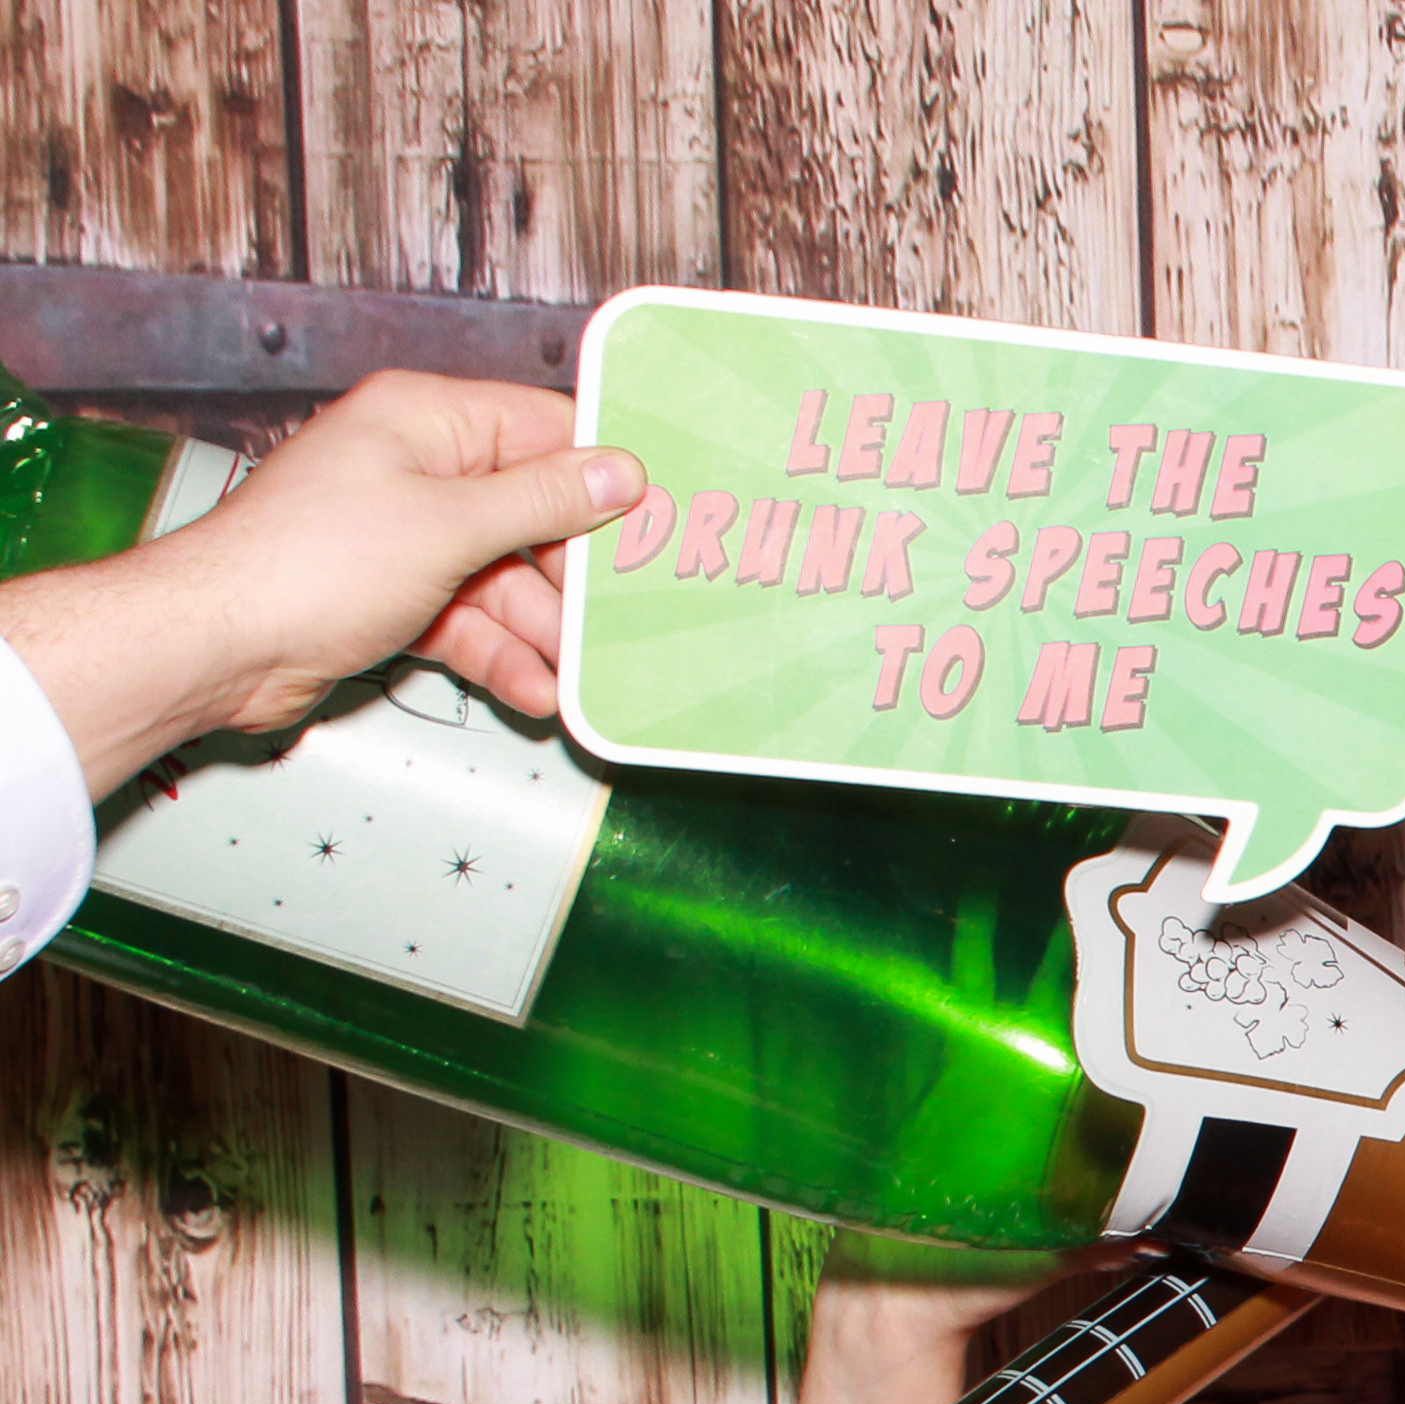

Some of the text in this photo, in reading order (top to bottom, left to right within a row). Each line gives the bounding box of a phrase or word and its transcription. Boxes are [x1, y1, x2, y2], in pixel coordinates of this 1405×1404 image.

[787, 388, 1267, 521] LEAVE THE
[613, 484, 928, 603] DRUNK
[873, 624, 1157, 732] TO ME
